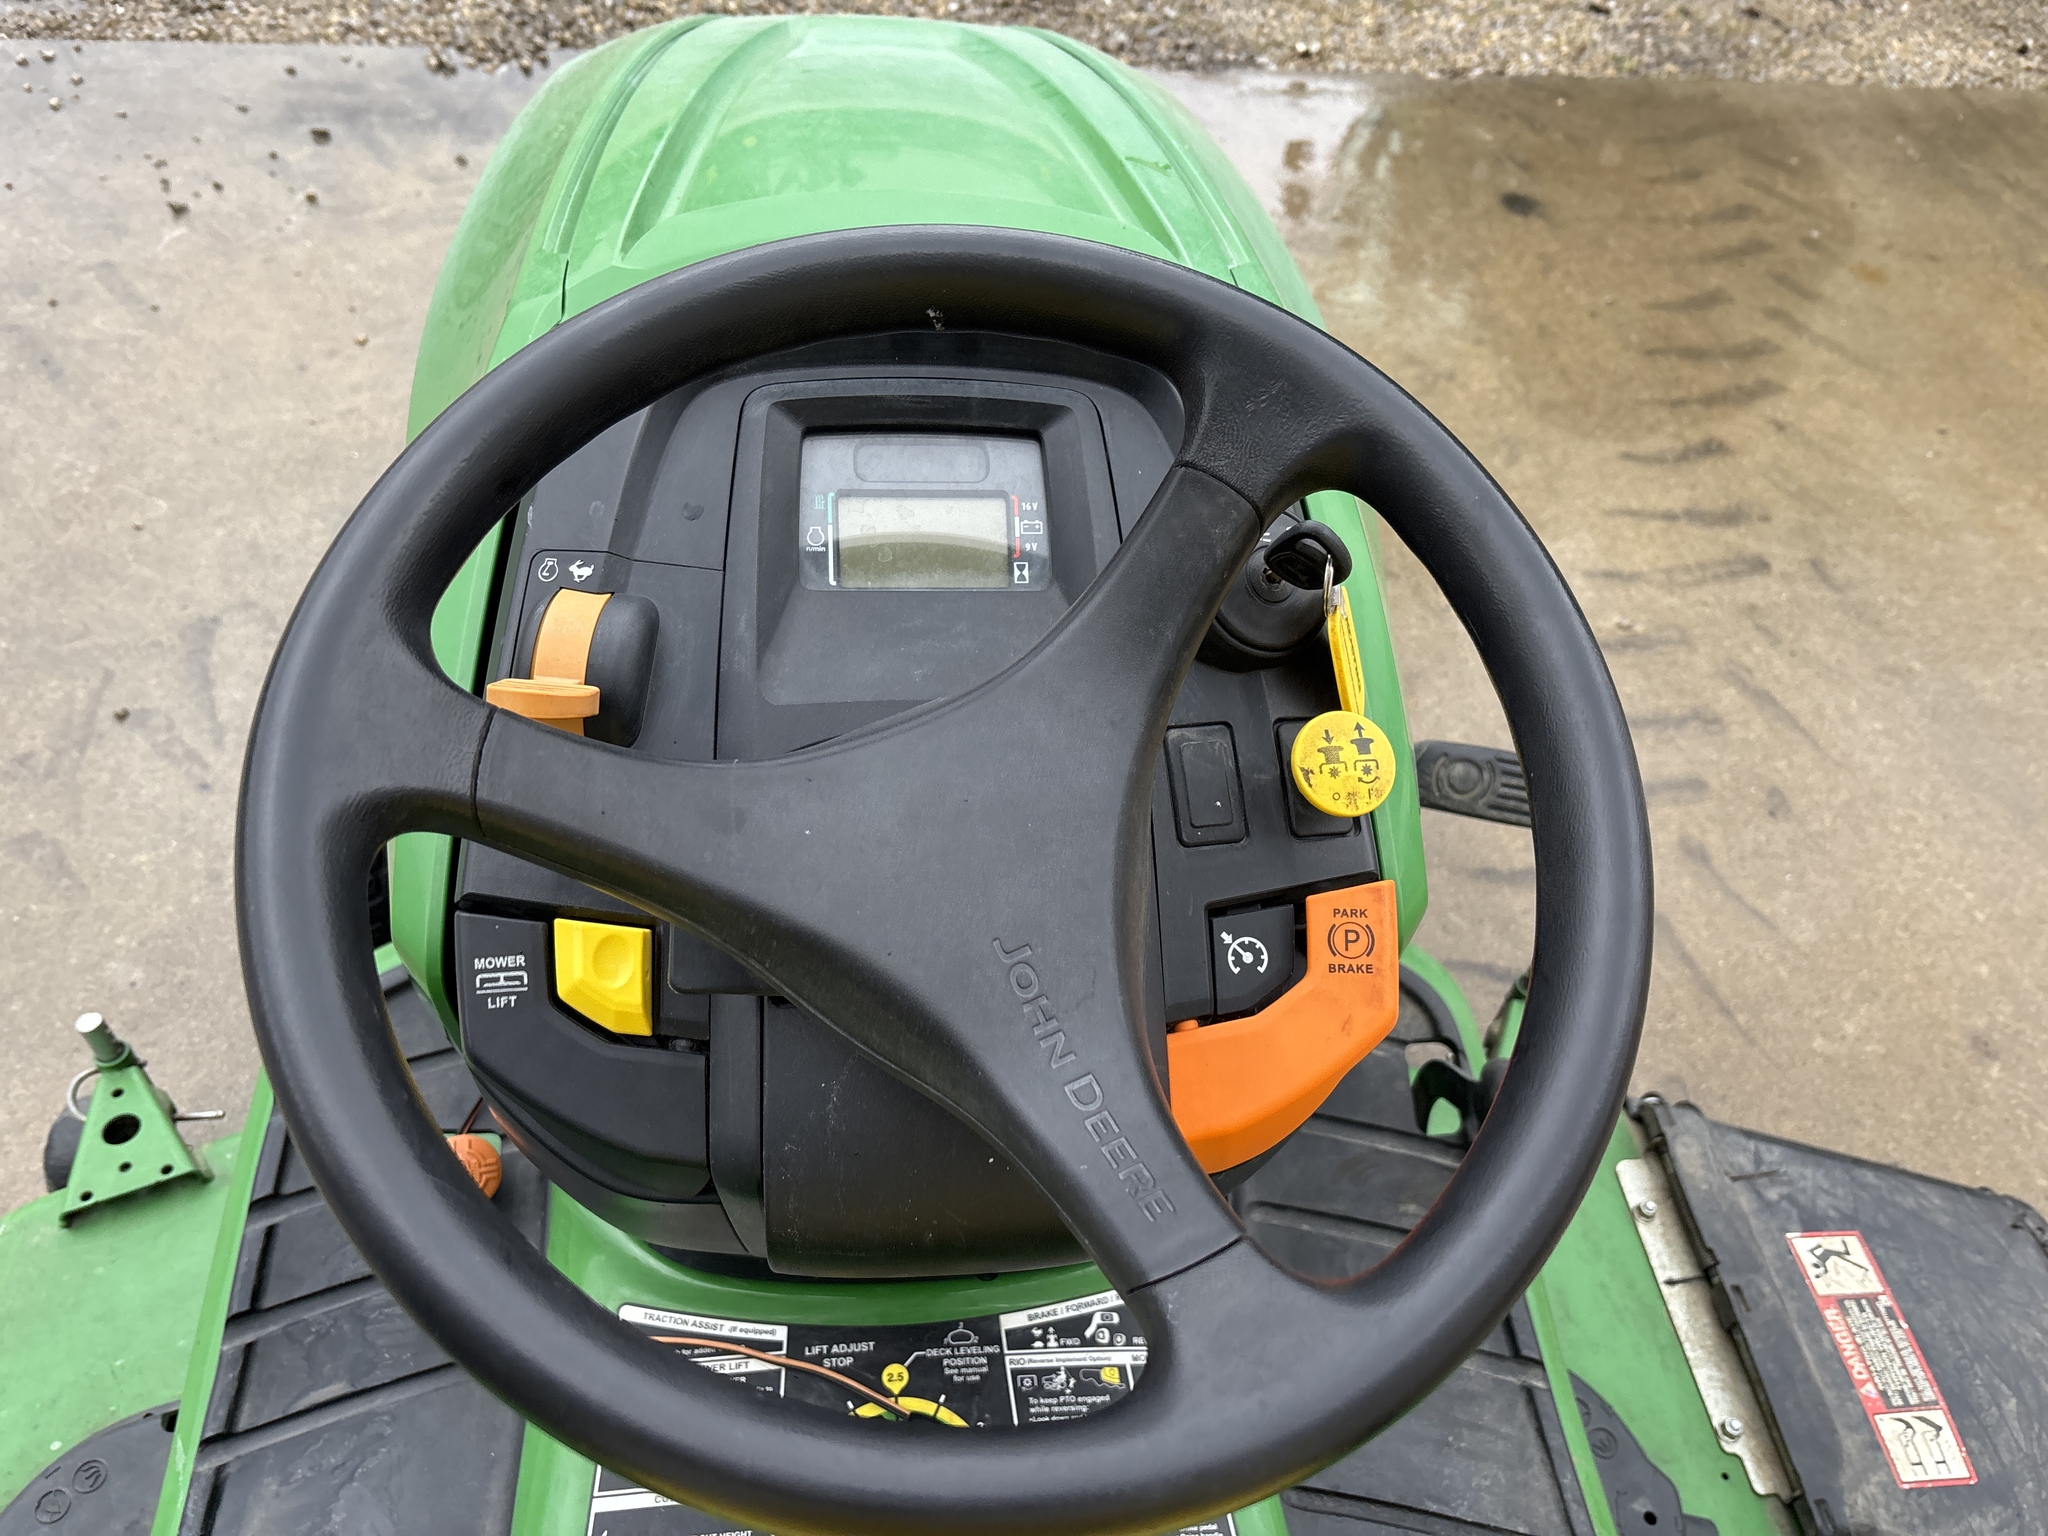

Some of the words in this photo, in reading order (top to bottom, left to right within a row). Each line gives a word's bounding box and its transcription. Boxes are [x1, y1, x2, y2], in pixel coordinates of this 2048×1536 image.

[1333, 908, 1368, 918] PARK
[474, 954, 526, 970] MOWER
[1328, 963, 1374, 974] BRAKE
[487, 995, 517, 1009] LIFT
[992, 937, 1077, 1069] JOHN
[1063, 1072, 1176, 1223] DEERE
[1027, 1308, 1059, 1322] BRAKE
[1065, 1296, 1110, 1313] FORWARD
[643, 1312, 690, 1327] TRACTION
[690, 1318, 726, 1333] ASSIST
[1060, 1337, 1081, 1346] FWD
[1823, 1306, 1869, 1380] DANGER
[804, 1344, 829, 1357] LIFT
[831, 1341, 876, 1354] ADJUST
[926, 1347, 952, 1357] DECK
[953, 1345, 1001, 1356] LEVELING
[729, 1361, 750, 1370] LIFT
[822, 1356, 855, 1368] STOP
[942, 1356, 988, 1367] POSITION
[1009, 1357, 1026, 1366] RIO
[944, 1367, 959, 1375] See
[960, 1365, 989, 1374] manual
[887, 1372, 904, 1383] 2.5
[966, 1374, 981, 1382] use
[1039, 1396, 1058, 1405] keep
[1059, 1395, 1076, 1403] PTO
[1077, 1393, 1110, 1403] engaged
[1029, 1405, 1050, 1413] while
